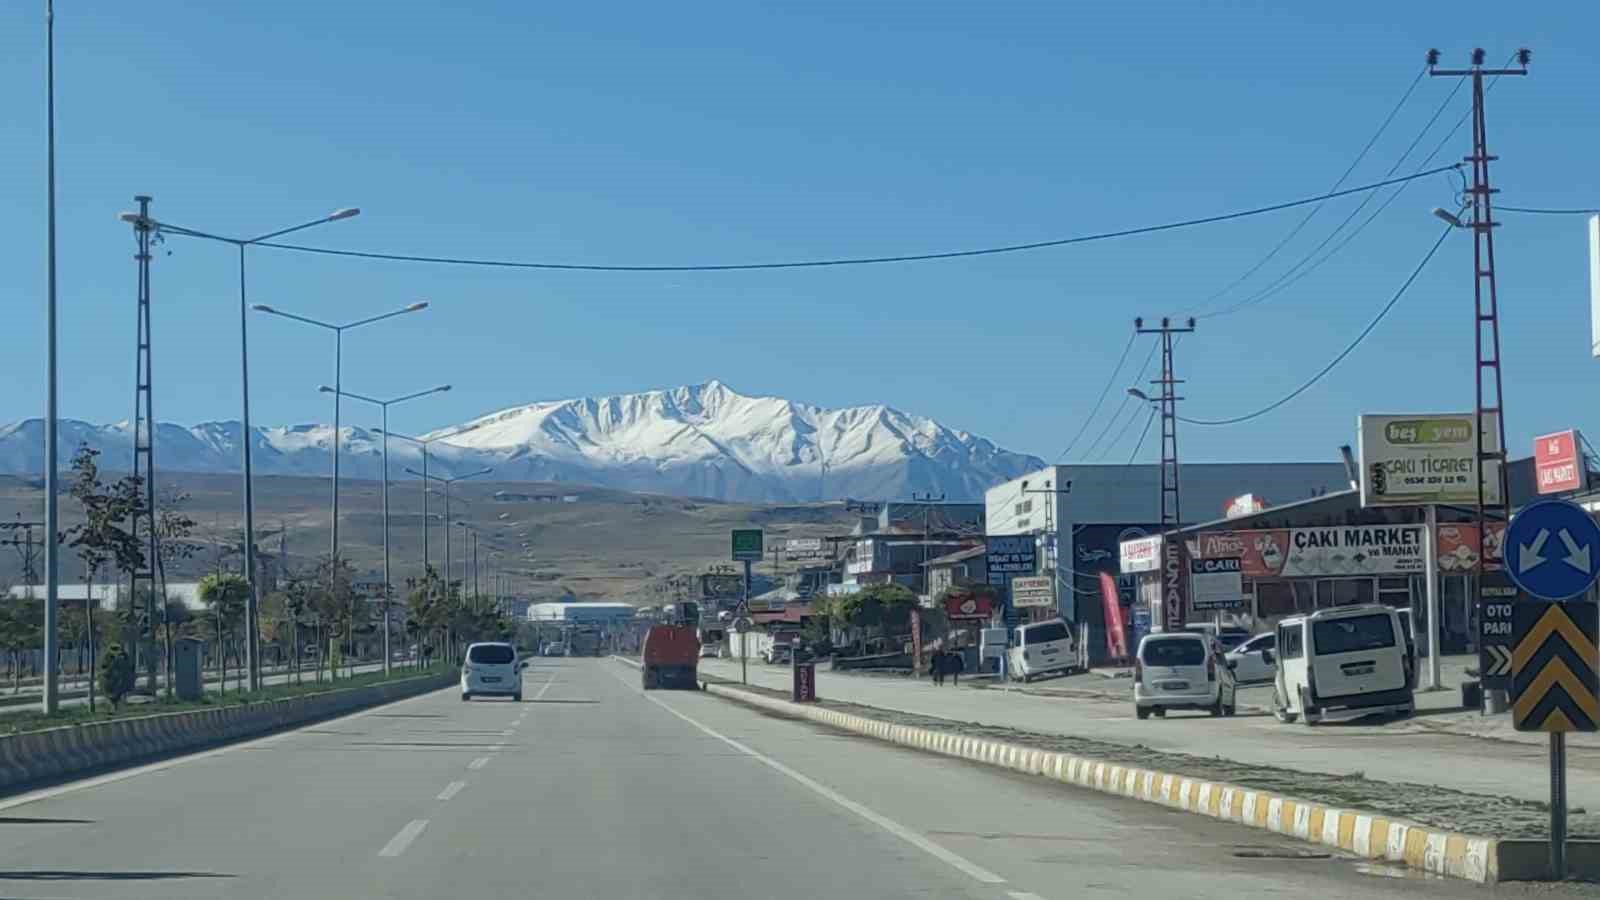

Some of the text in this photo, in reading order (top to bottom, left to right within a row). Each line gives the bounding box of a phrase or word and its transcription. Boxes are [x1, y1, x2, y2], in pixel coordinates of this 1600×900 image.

[1295, 530, 1339, 553] ÇAKI
[1344, 528, 1421, 547] MARKET
[1383, 545, 1420, 556] MANAV
[1486, 604, 1512, 617] OTO
